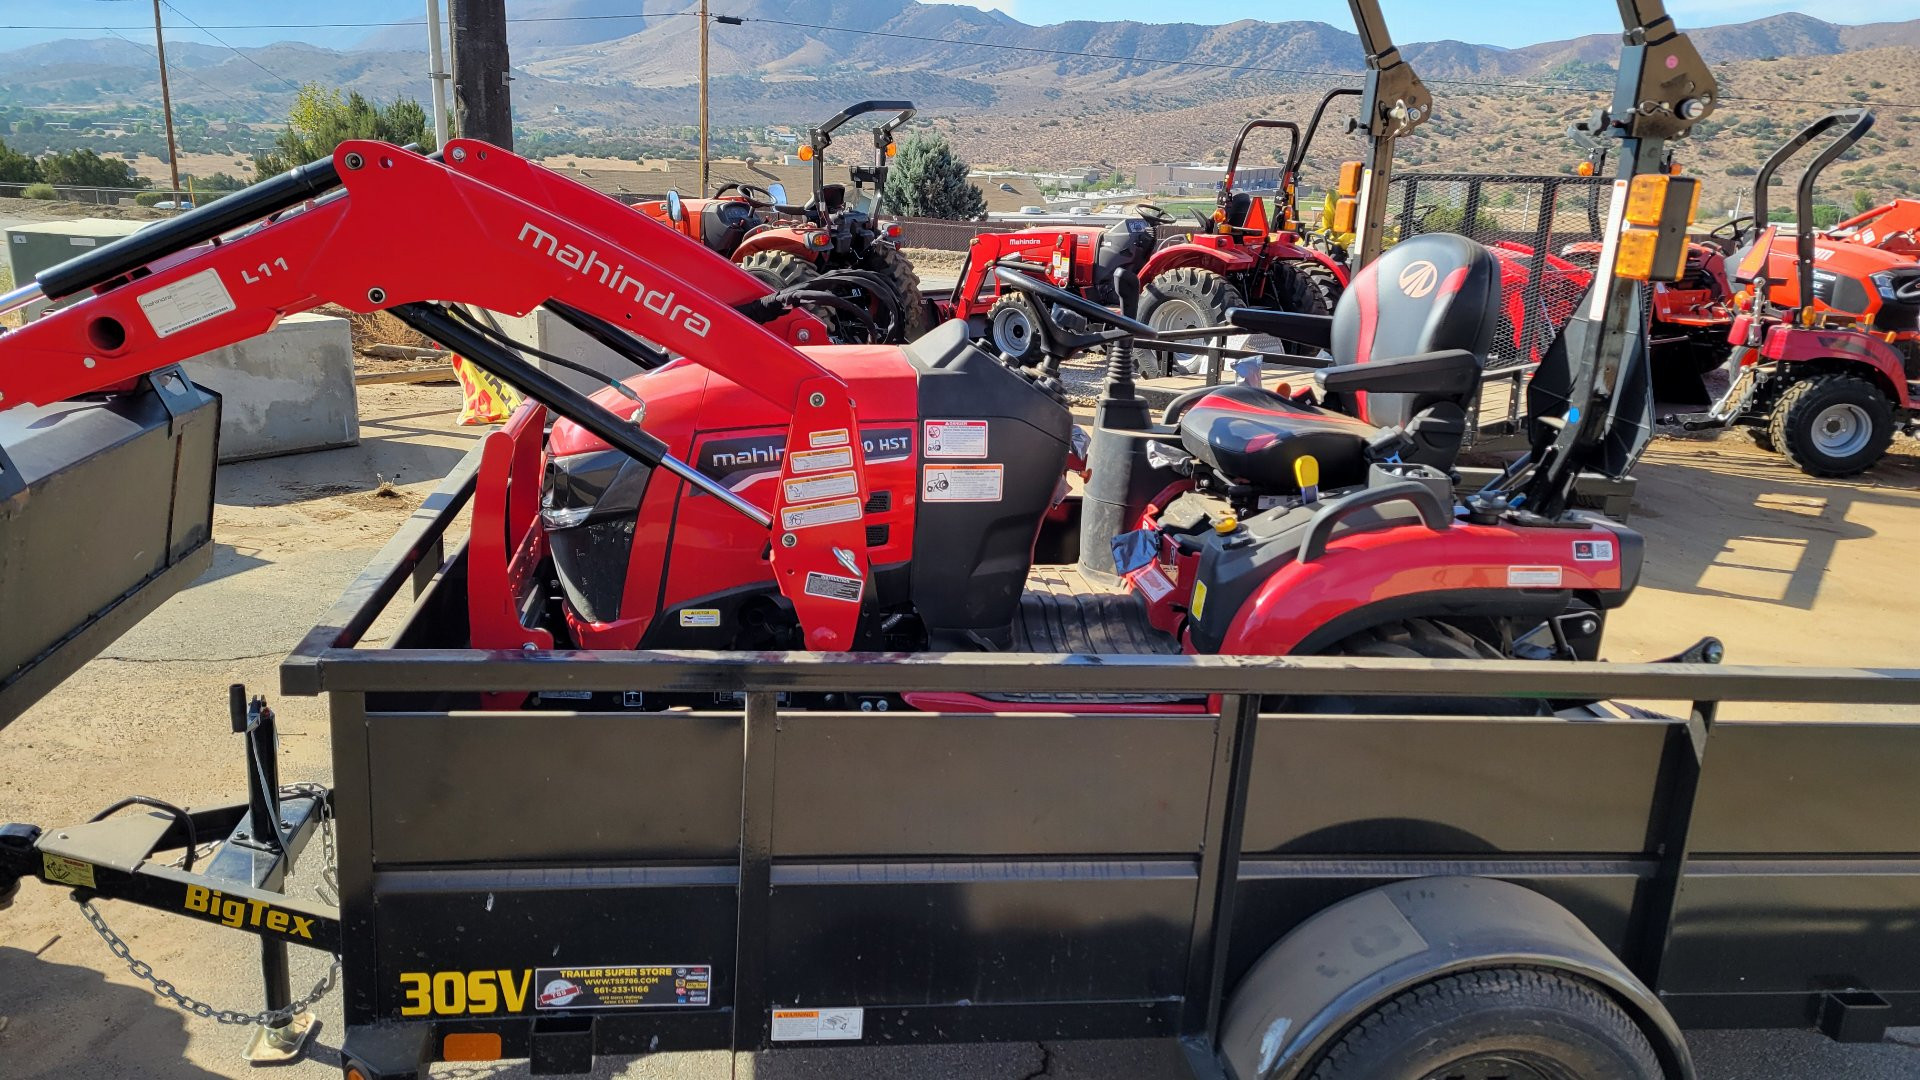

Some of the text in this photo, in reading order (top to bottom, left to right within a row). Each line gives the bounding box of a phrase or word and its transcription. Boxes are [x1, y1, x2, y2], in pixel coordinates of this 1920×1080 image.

[1009, 238, 1041, 246] Mahindra
[241, 257, 289, 285] L11
[517, 221, 711, 338] mahindra
[878, 436, 908, 451] HST
[183, 883, 315, 940] BigTex
[560, 969, 602, 978] TRAILER
[604, 968, 638, 977] SUPER
[641, 968, 672, 976] STORE
[399, 969, 533, 1017] 30SV
